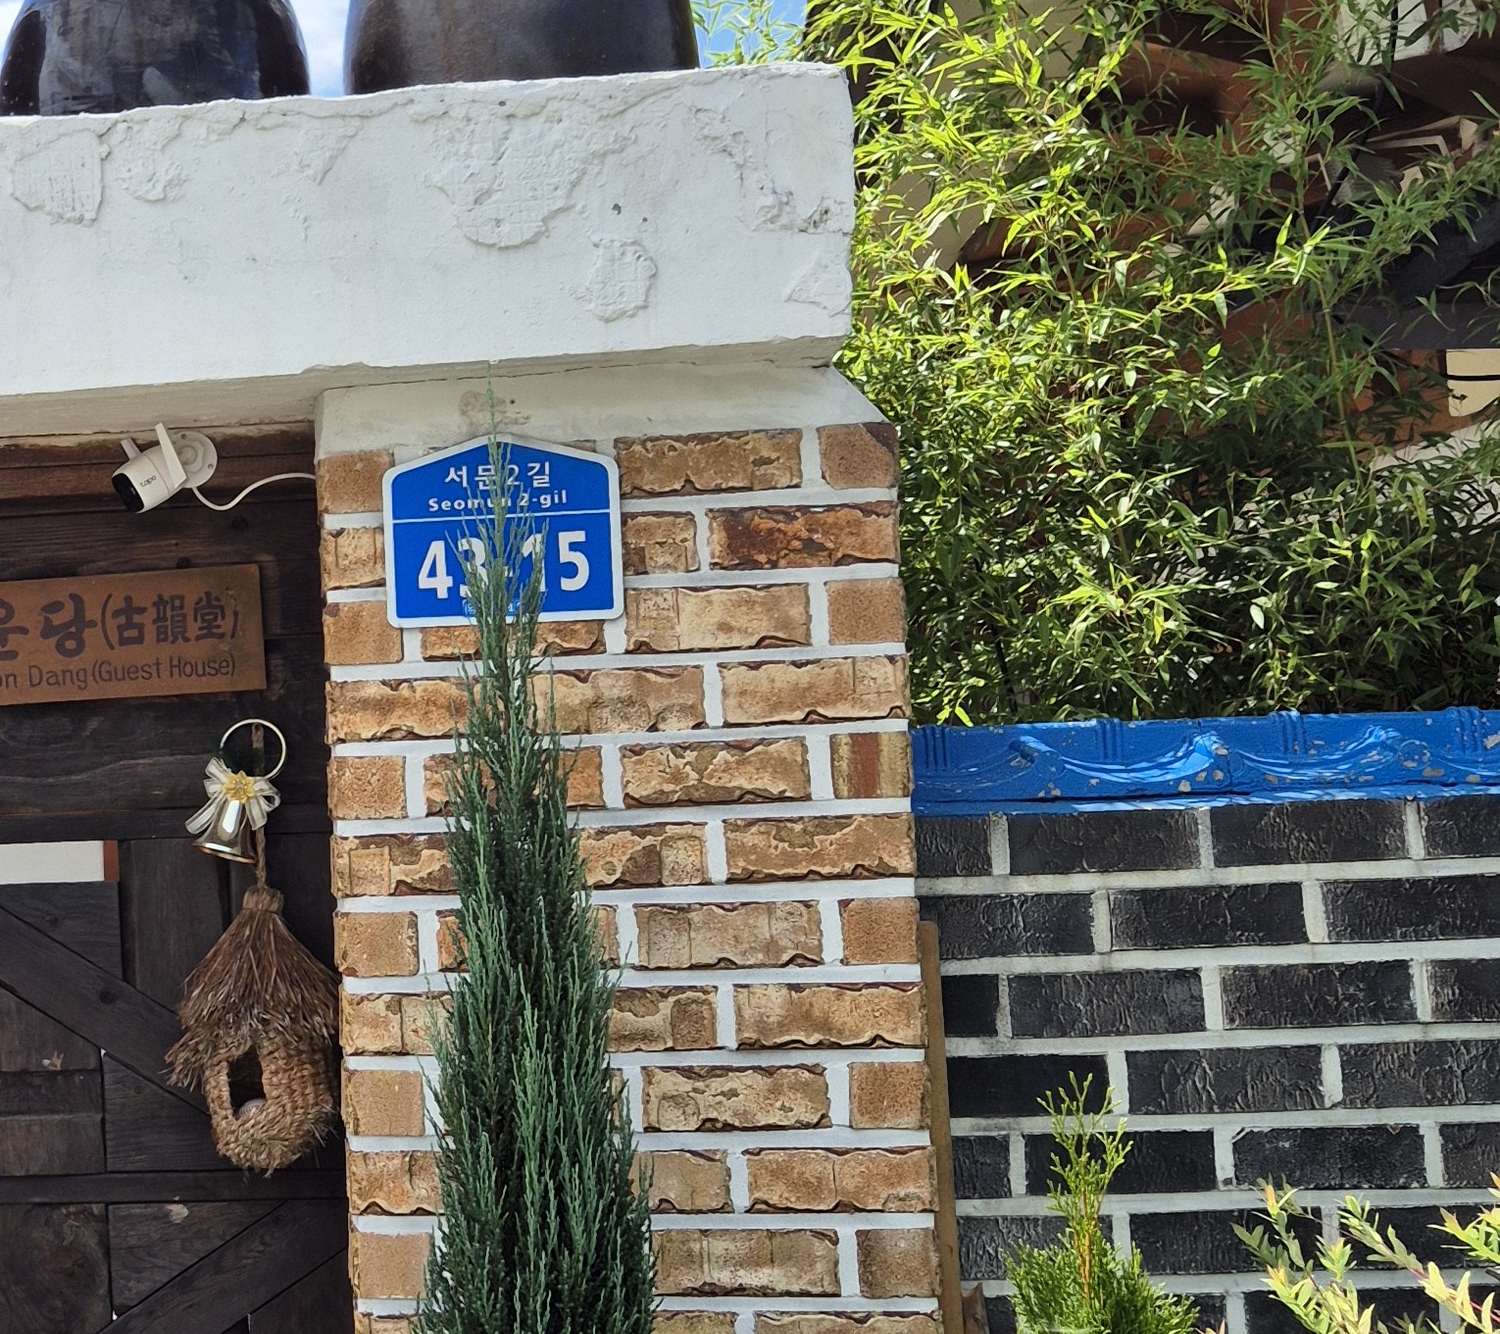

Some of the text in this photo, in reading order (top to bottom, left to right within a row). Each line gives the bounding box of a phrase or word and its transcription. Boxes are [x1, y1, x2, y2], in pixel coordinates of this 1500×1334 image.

[444, 461, 550, 490] 서문2길
[519, 489, 567, 508] 2-gil
[169, 653, 236, 678] House)
